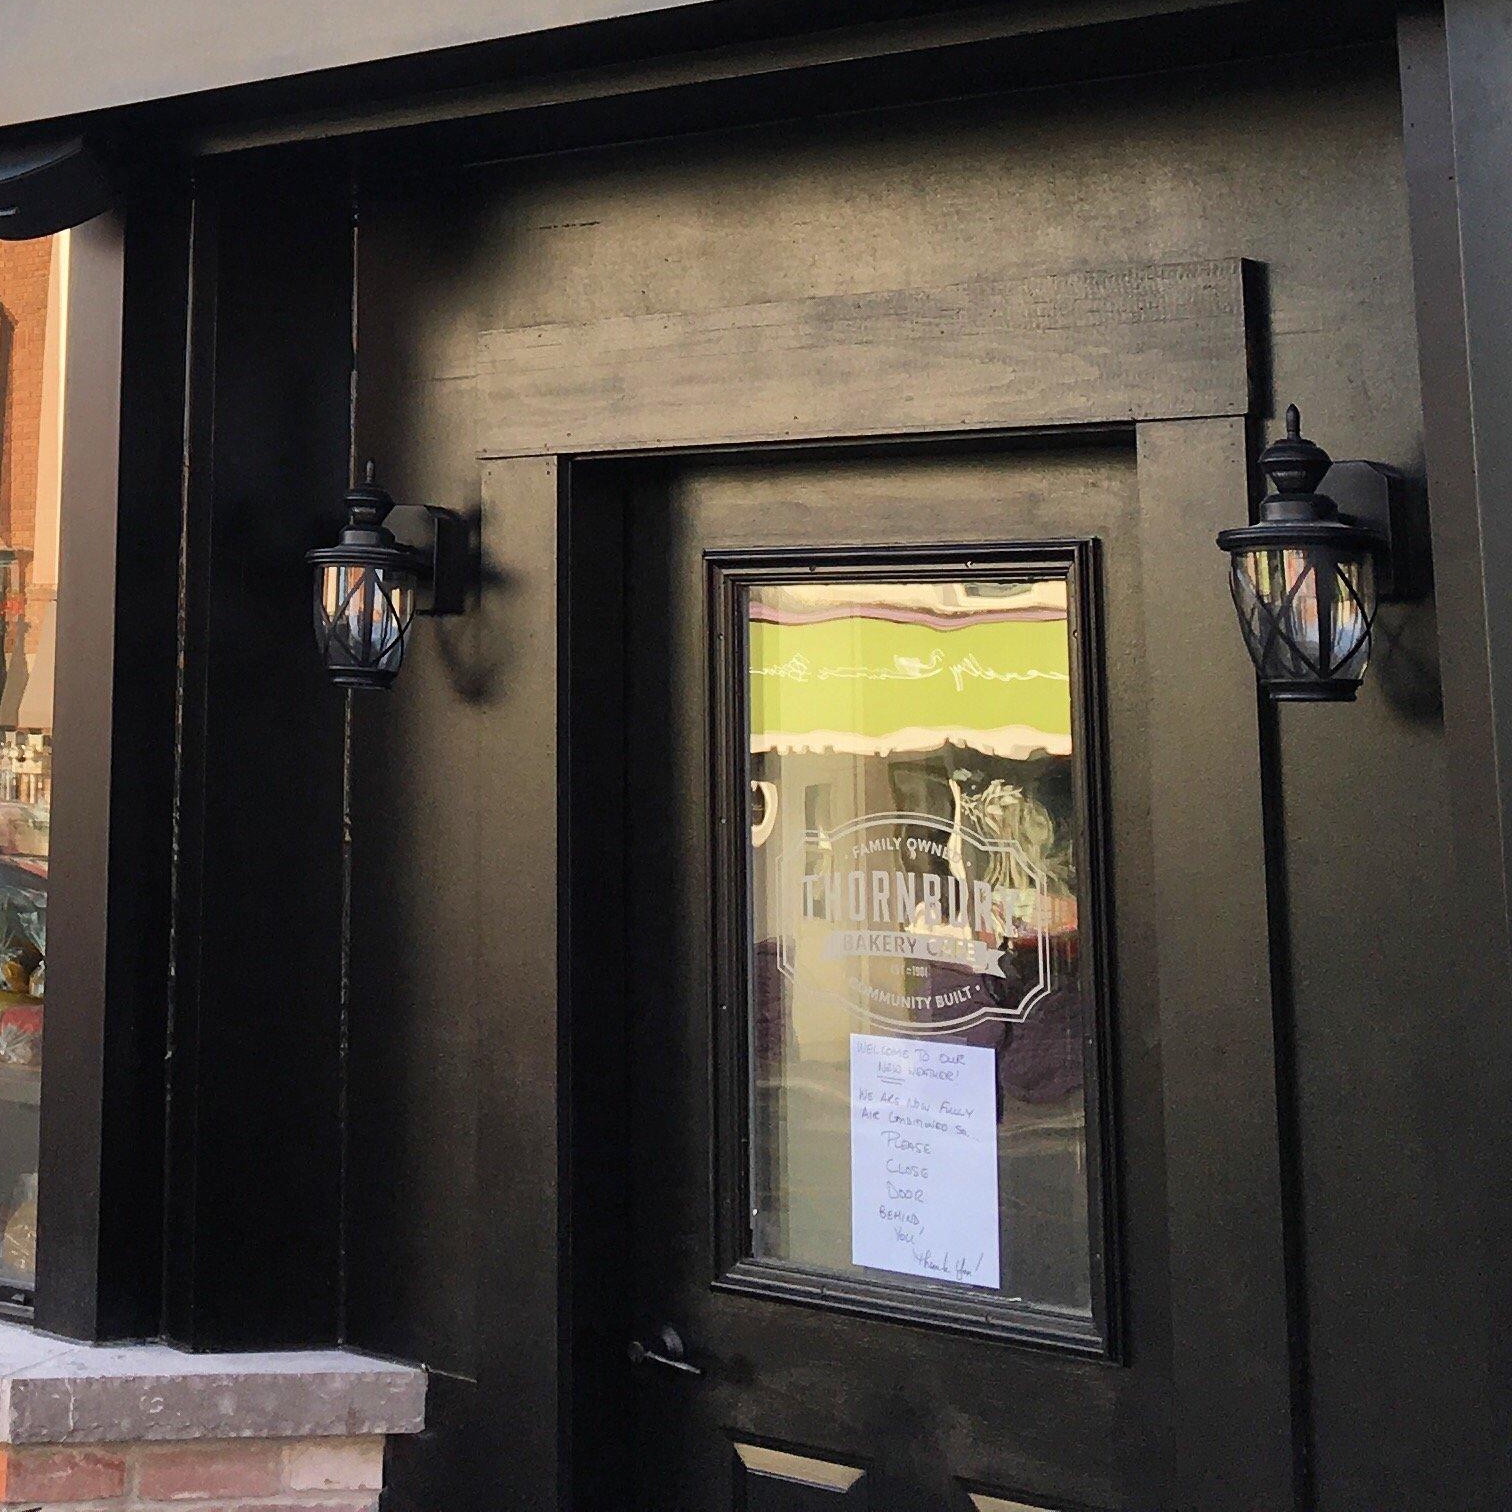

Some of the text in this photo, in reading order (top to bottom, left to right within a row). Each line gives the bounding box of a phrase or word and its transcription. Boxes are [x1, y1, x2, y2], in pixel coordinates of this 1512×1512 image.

[852, 837, 902, 859] FAMILY
[843, 934, 917, 954] BAKERY
[935, 985, 971, 1009] BUILT
[915, 1048, 930, 1062] TO
[939, 1053, 966, 1066] OUR
[881, 1130, 932, 1155] PLEASE
[886, 1158, 929, 1179] CLOSE
[886, 1180, 925, 1203] DOOR
